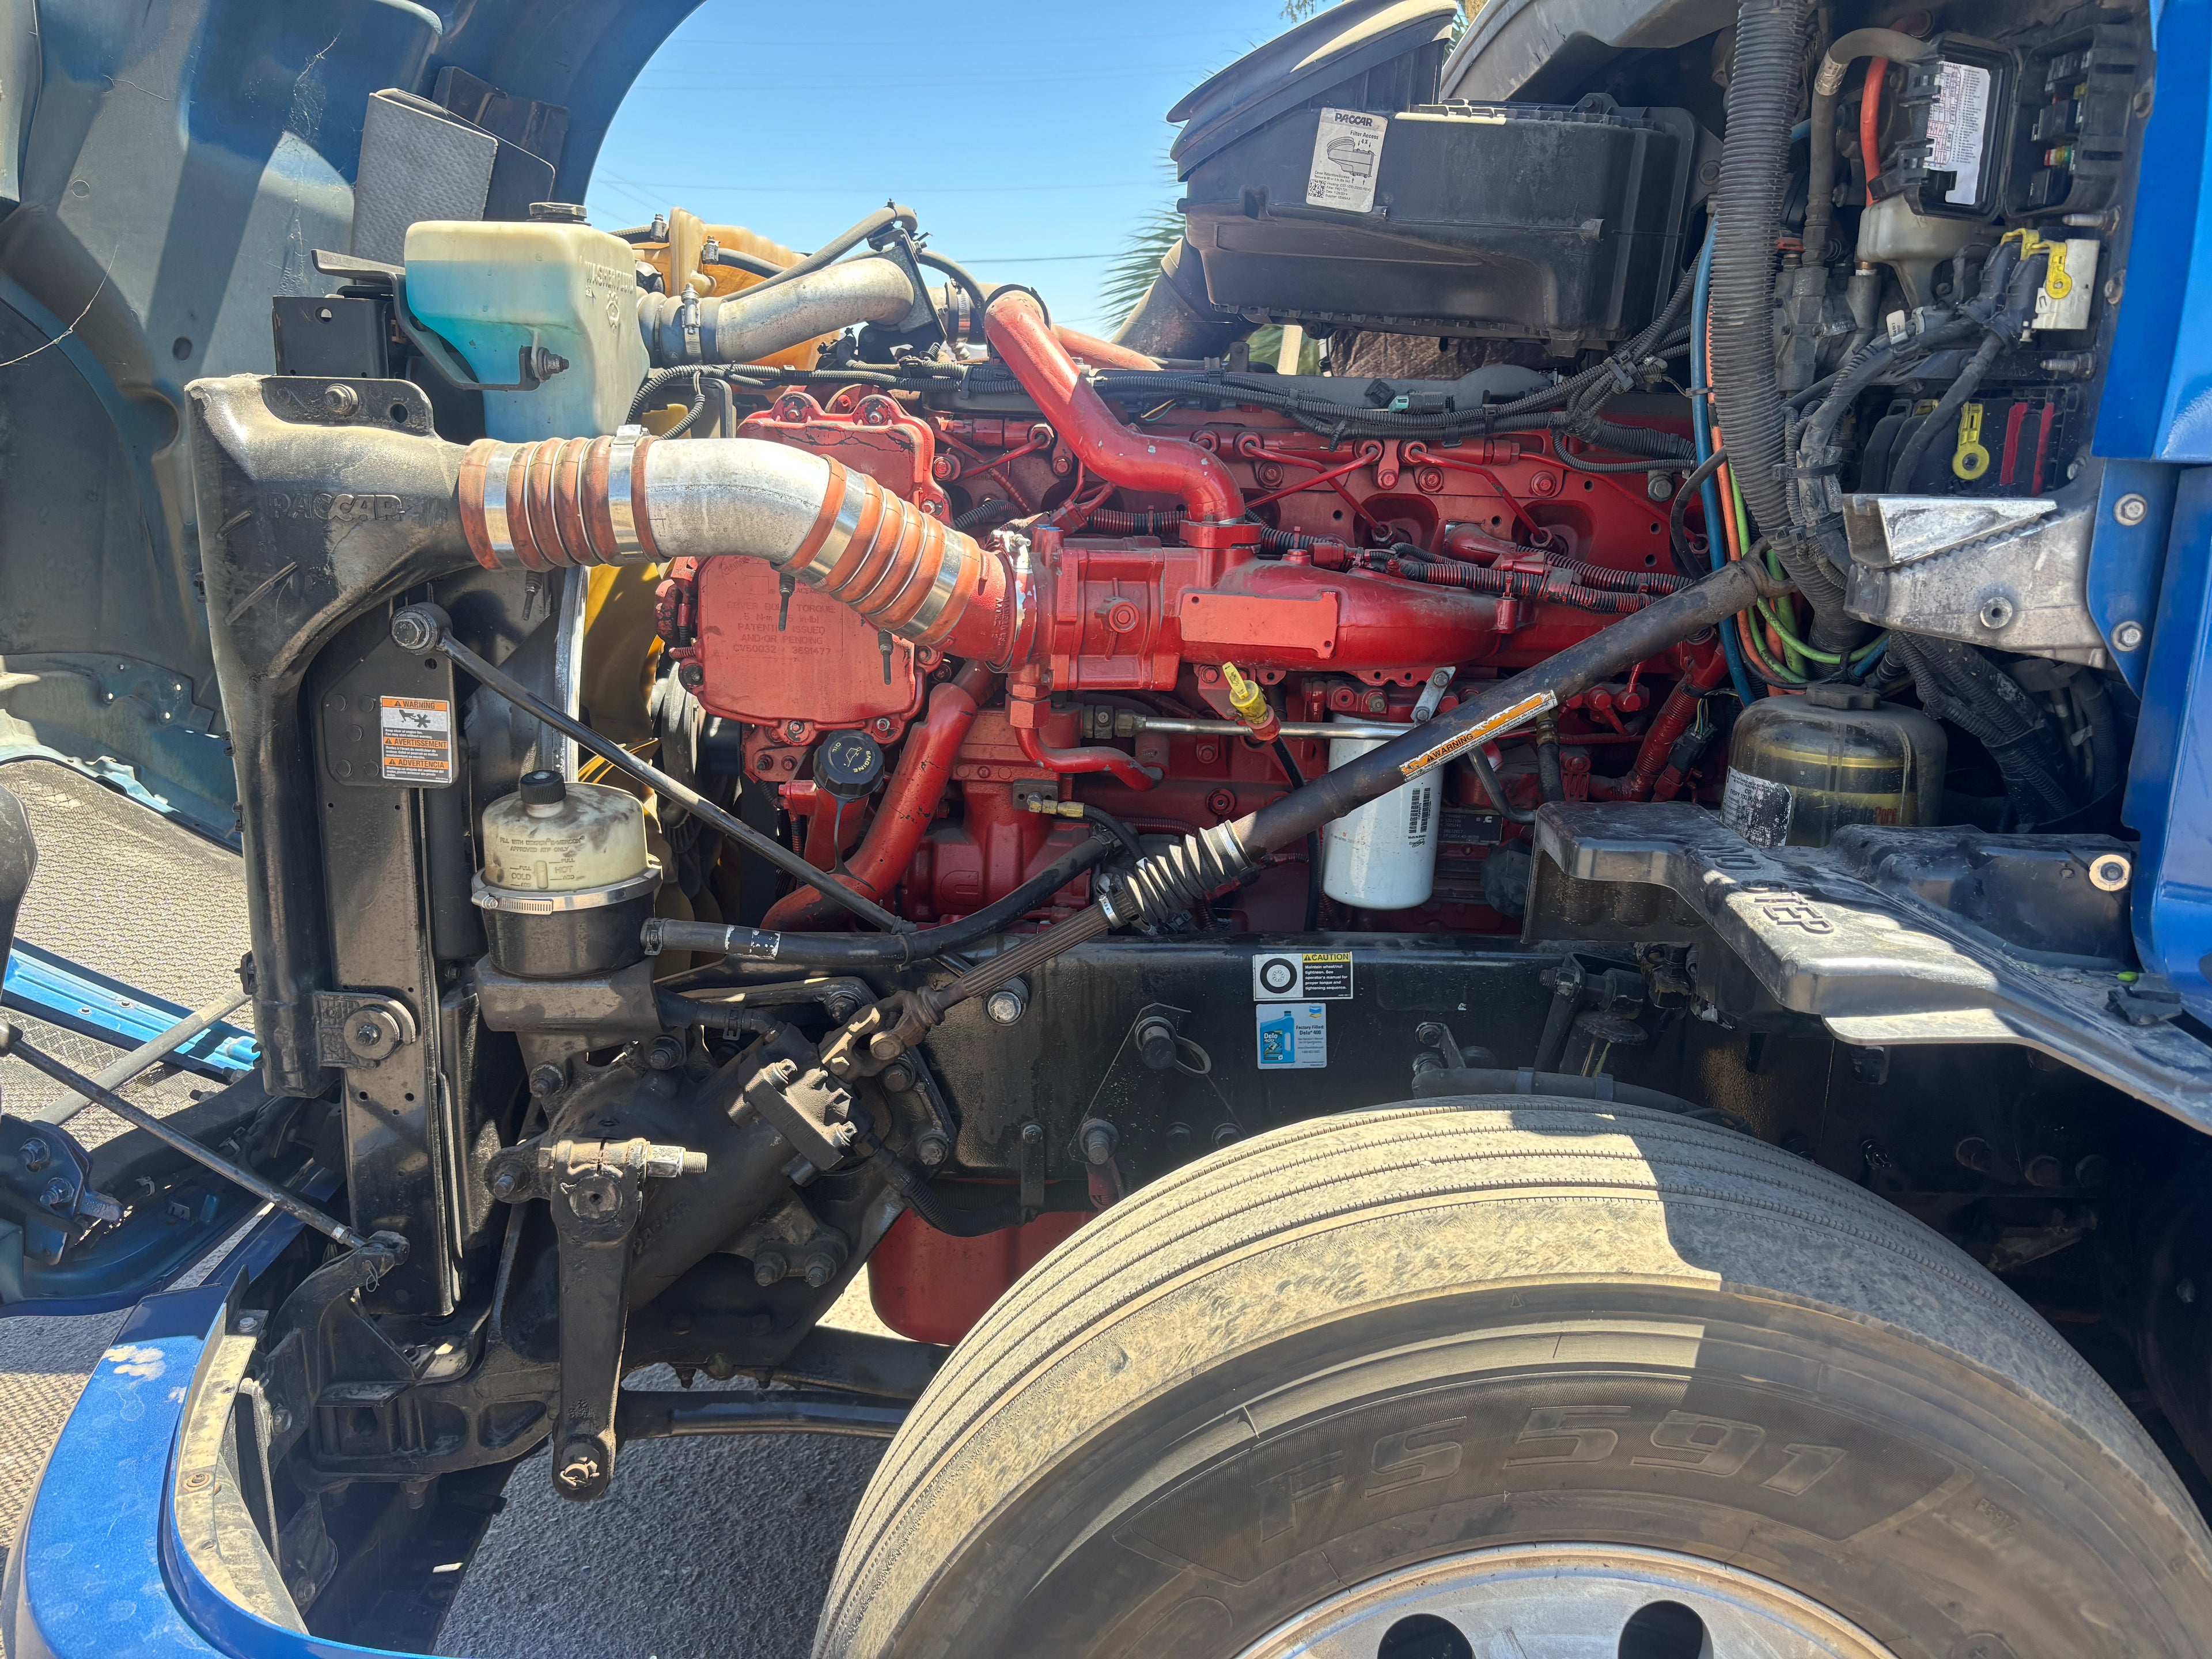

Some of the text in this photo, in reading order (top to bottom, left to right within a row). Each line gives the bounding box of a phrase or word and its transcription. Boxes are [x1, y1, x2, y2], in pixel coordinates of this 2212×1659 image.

[1334, 112, 1373, 127] PACCAR
[1362, 132, 1379, 140] Access
[267, 491, 404, 522] PACCAR
[792, 625, 825, 635] ISSUED
[741, 634, 823, 645] AND/OR PENDING
[403, 700, 435, 709] WARNING
[394, 738, 447, 748] AVERTISSEMENT
[832, 742, 842, 752] OIL
[1432, 733, 1474, 758] WARNING
[398, 759, 445, 769] ADVERTENCIA
[853, 751, 872, 773] ENGINE
[555, 866, 574, 874] HOT
[511, 872, 532, 881] COLD
[1740, 879, 1835, 935] STEP
